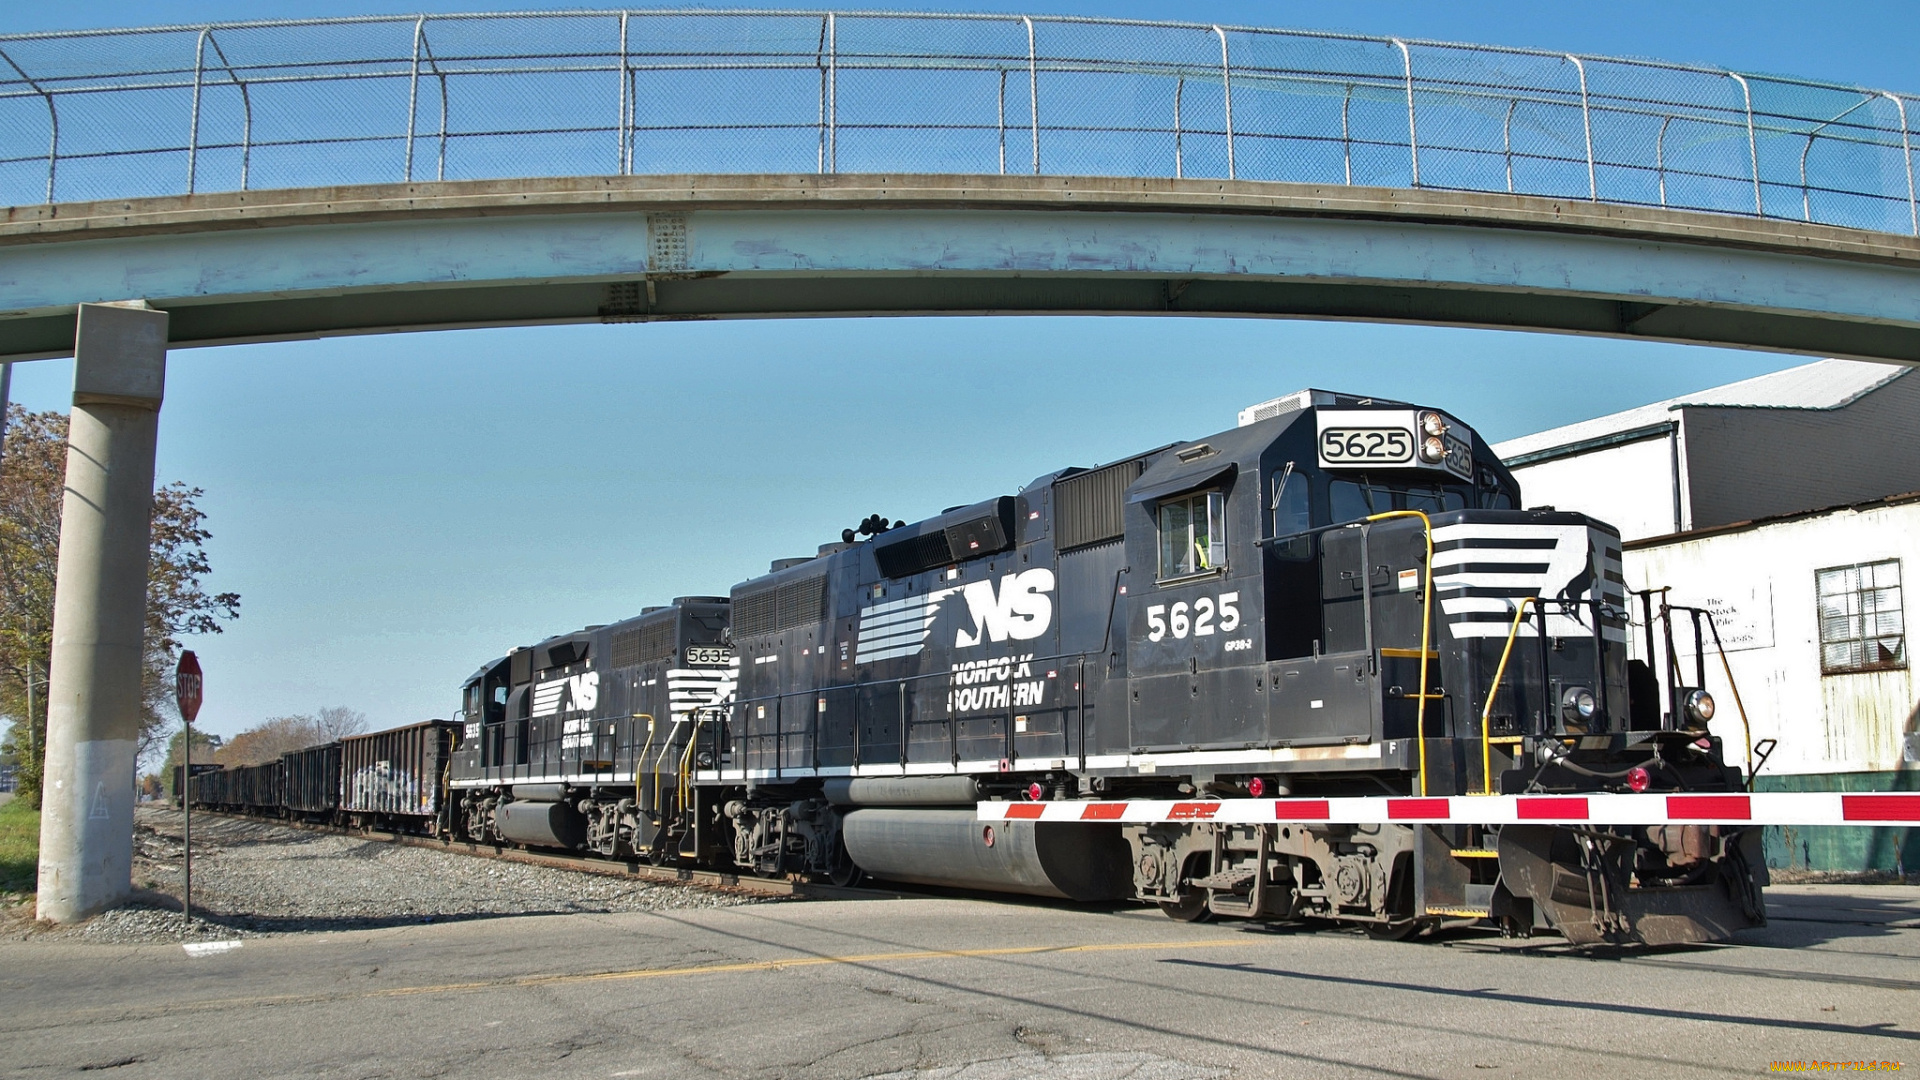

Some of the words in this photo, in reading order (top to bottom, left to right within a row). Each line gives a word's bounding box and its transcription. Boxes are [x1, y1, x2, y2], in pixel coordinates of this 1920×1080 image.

[1325, 432, 1406, 457] 5625
[1444, 438, 1471, 473] 5625
[955, 567, 1055, 648] NS
[1147, 591, 1240, 642] 5625
[688, 649, 730, 663] 5635
[1224, 639, 1252, 652] GP38-2
[177, 673, 201, 699] STOP
[566, 671, 599, 712] NS
[1389, 741, 1397, 755] F
